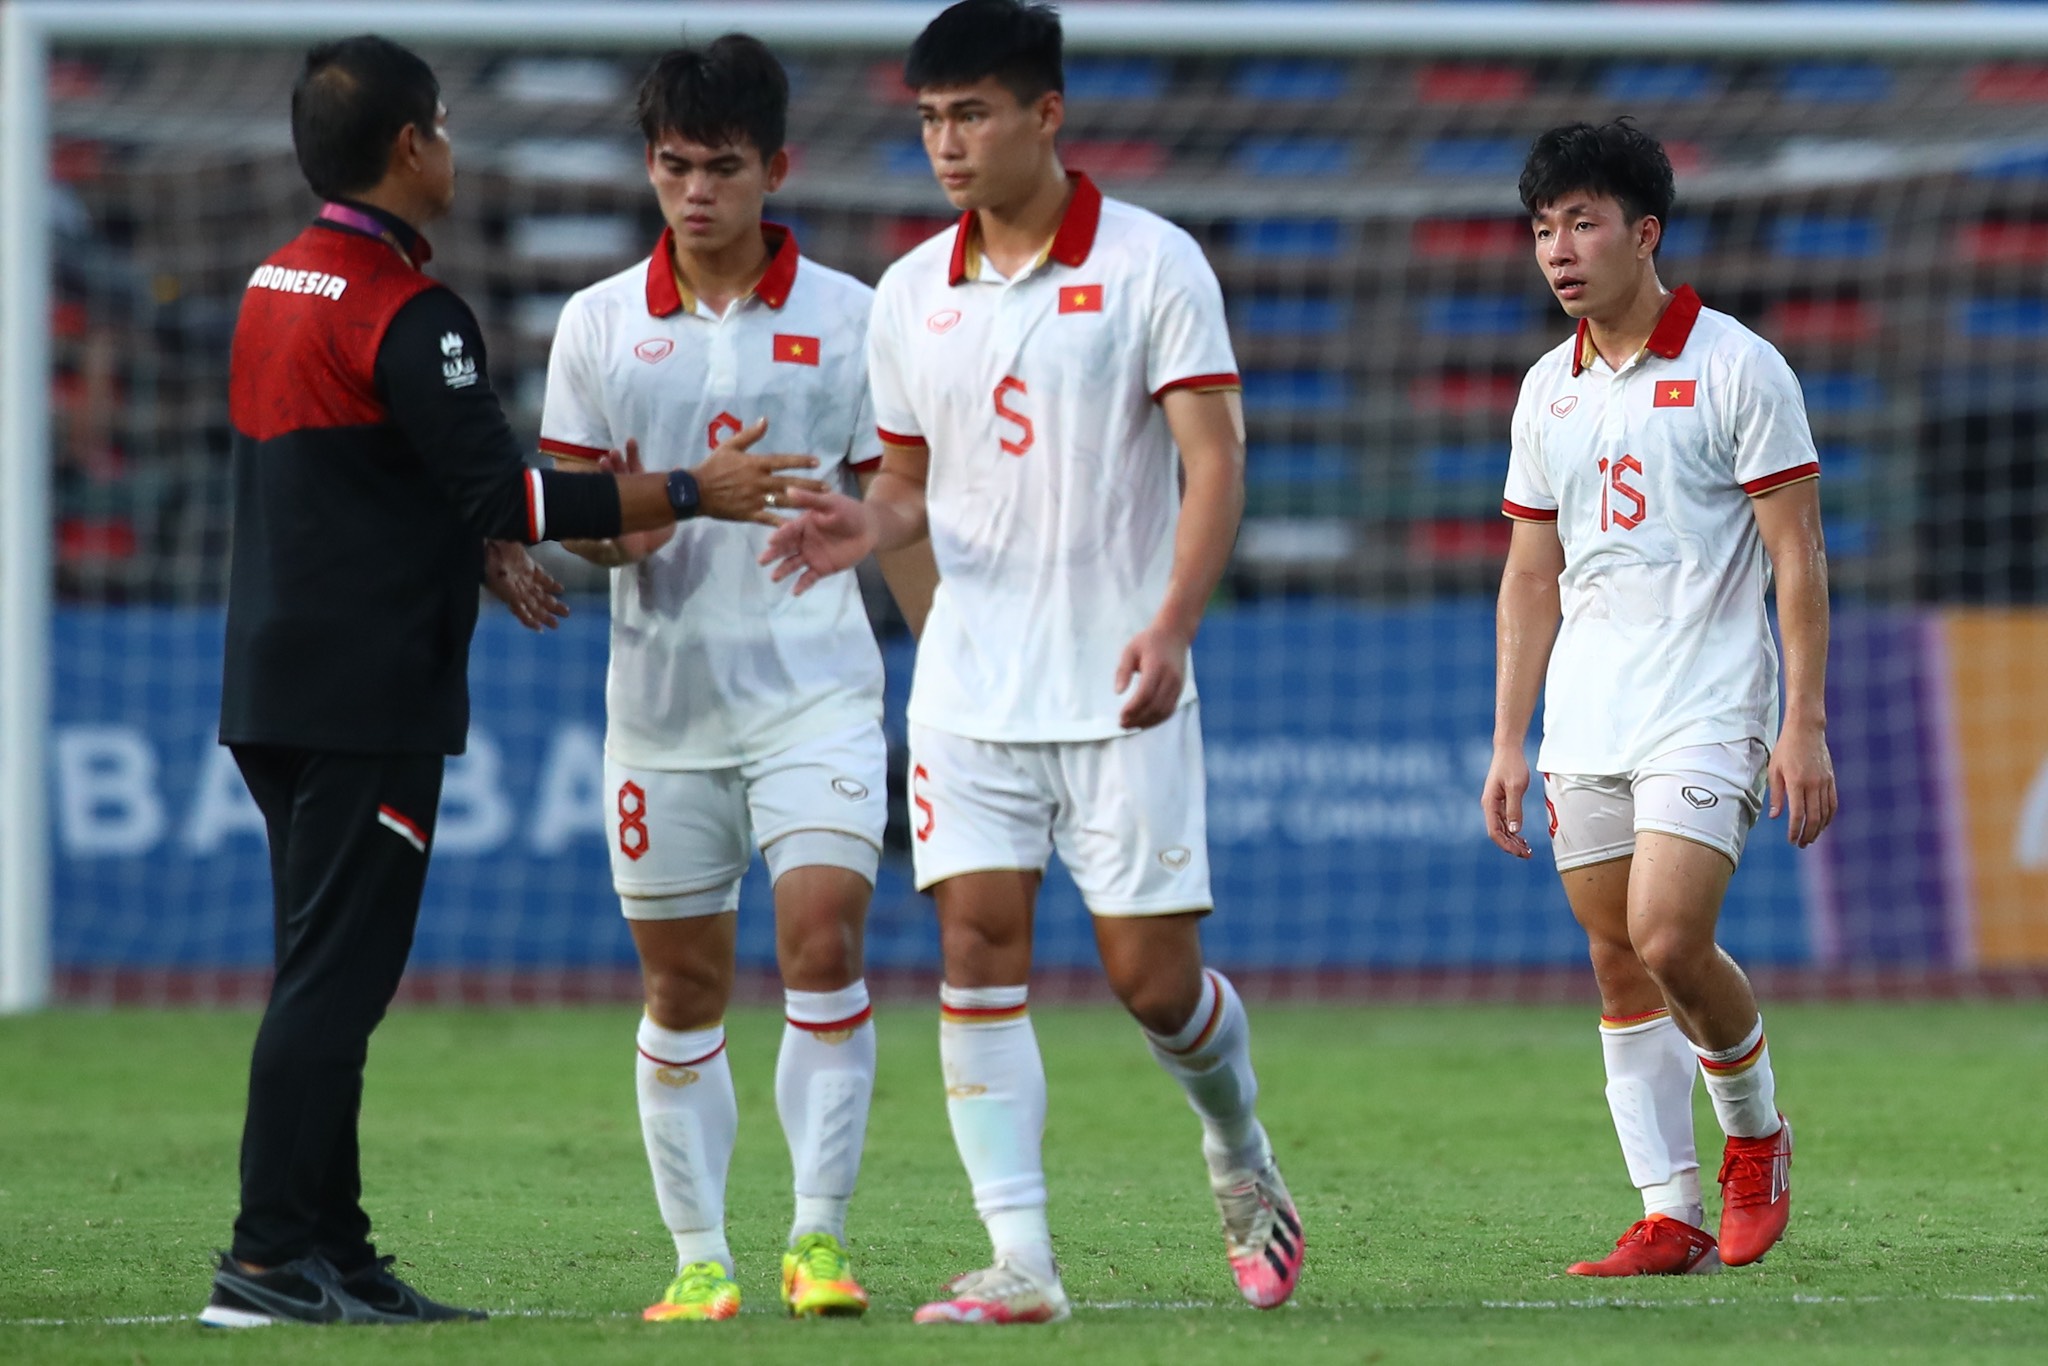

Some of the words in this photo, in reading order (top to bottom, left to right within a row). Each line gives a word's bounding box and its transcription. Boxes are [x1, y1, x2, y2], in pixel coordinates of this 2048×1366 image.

[248, 264, 348, 301] NDONESIA
[993, 375, 1036, 458] 5
[1597, 453, 1647, 532] 15
[618, 779, 649, 861] 8
